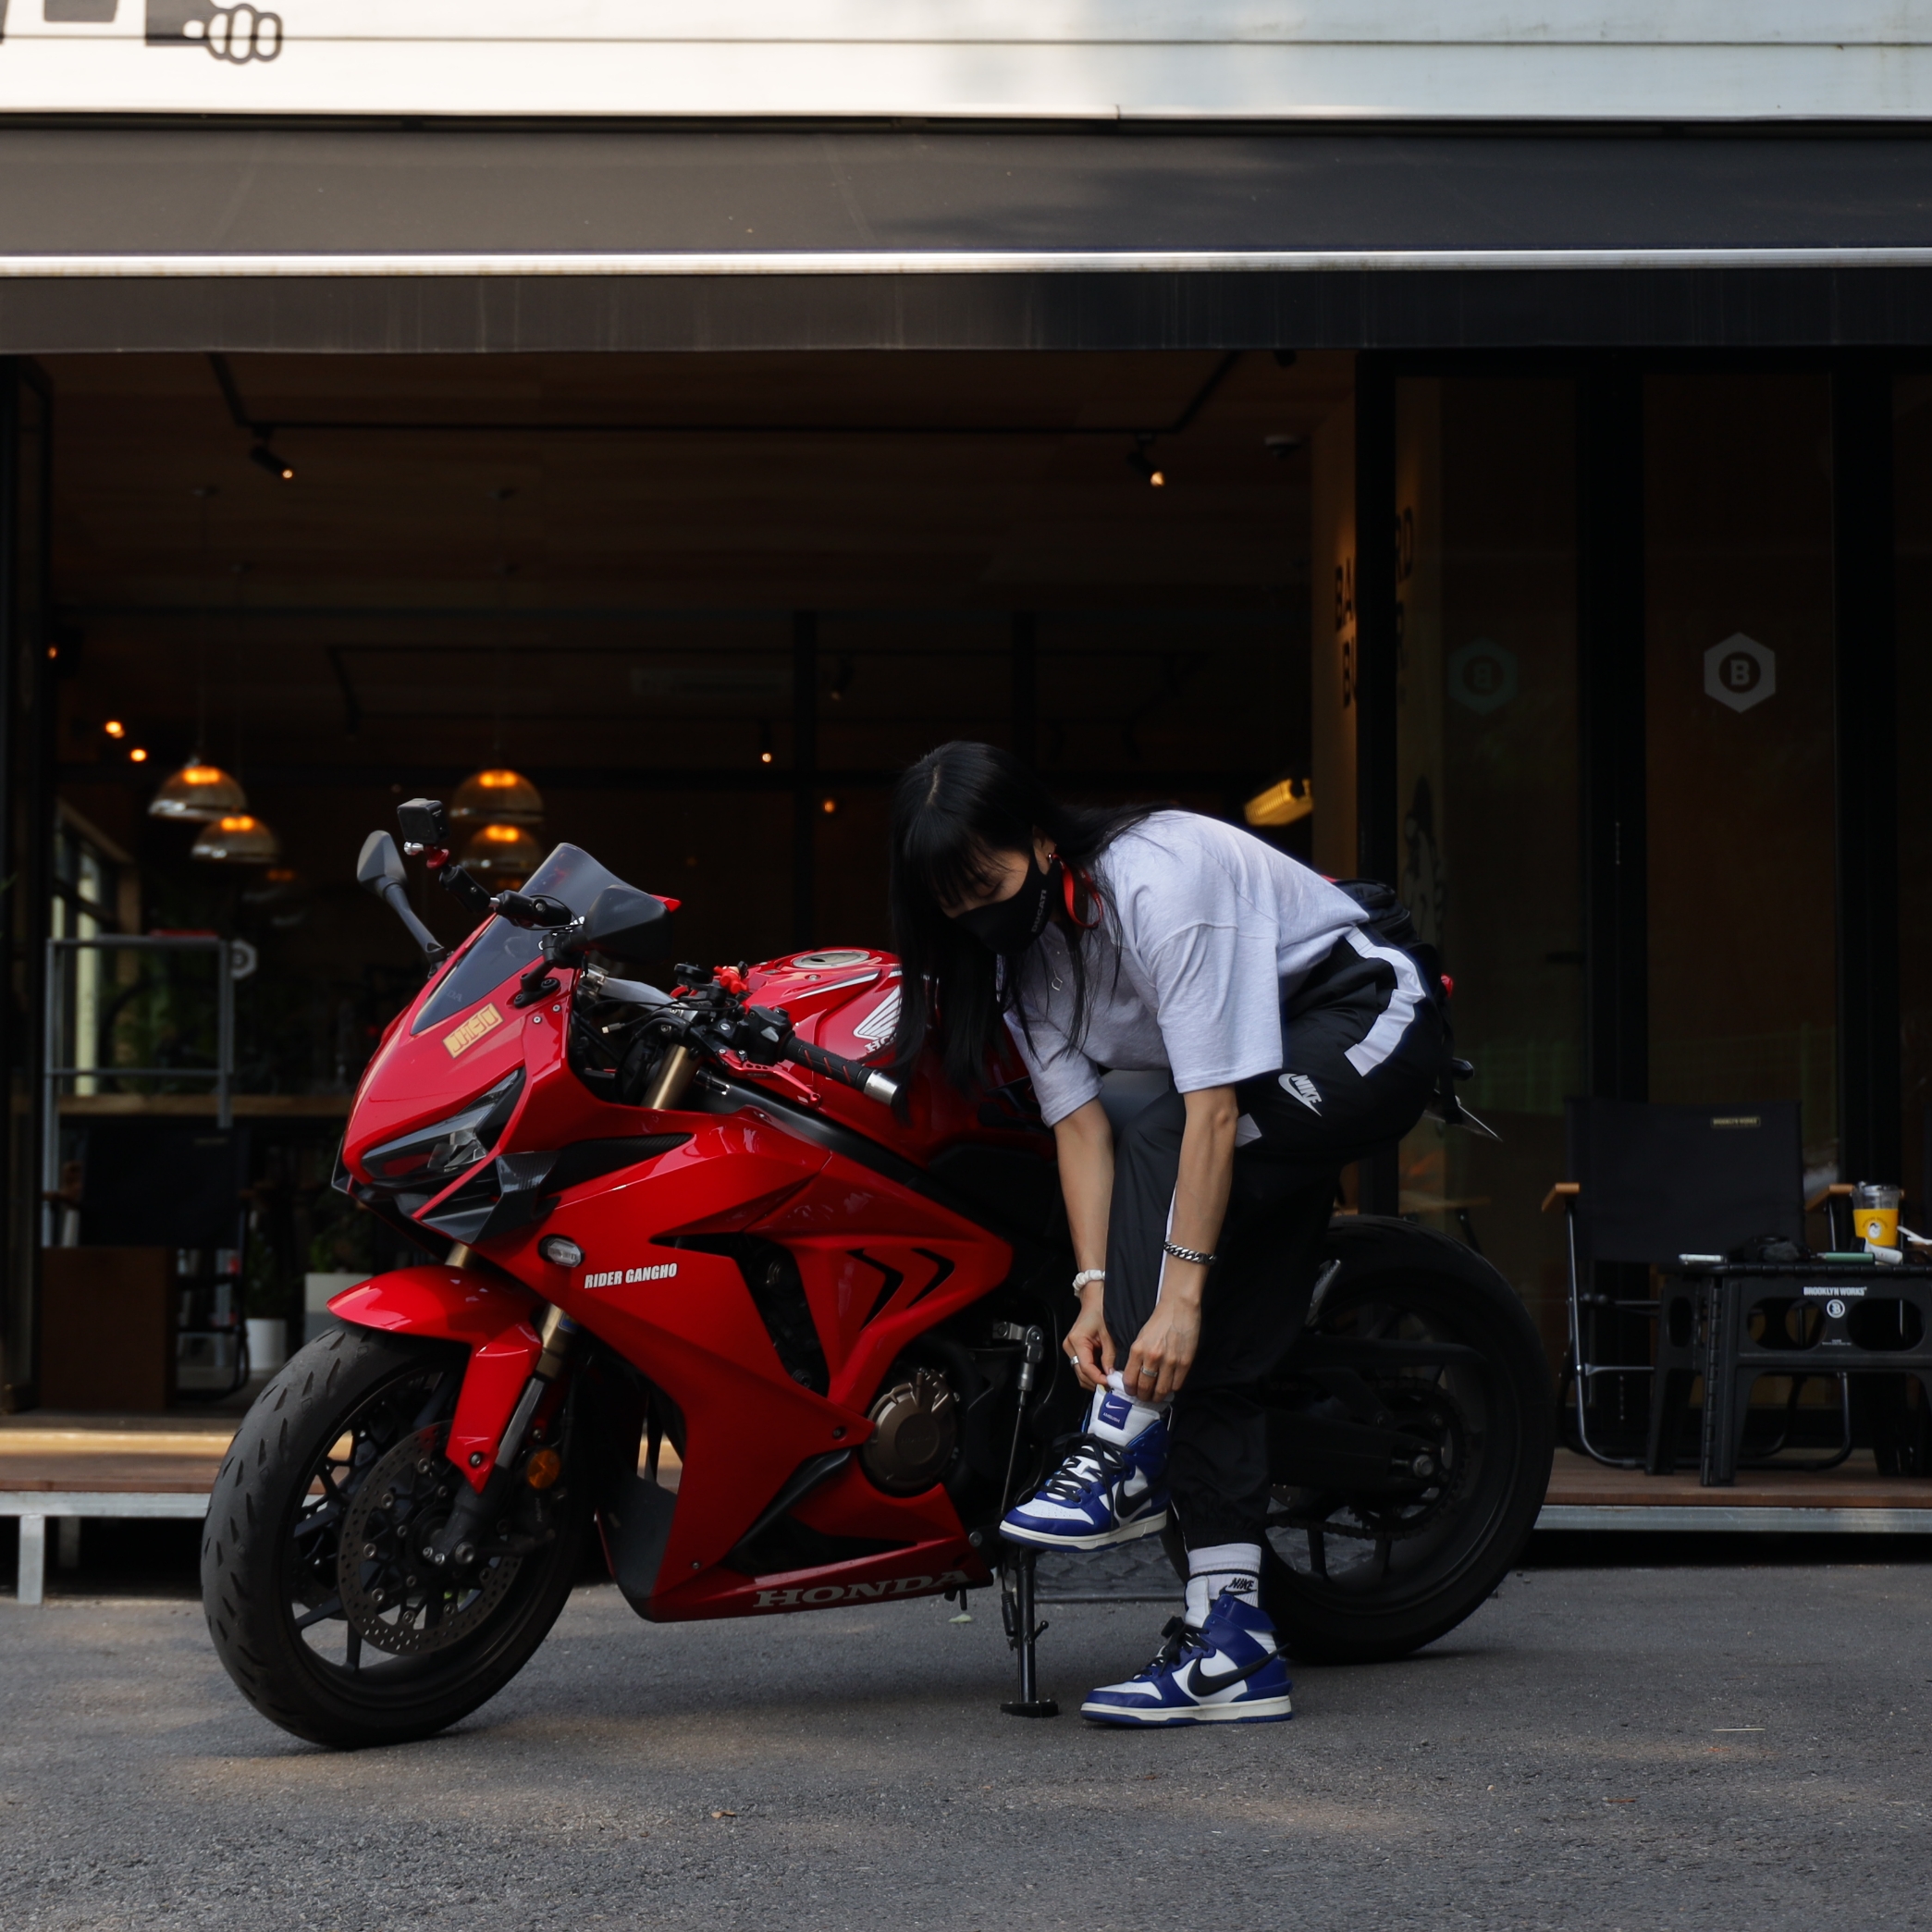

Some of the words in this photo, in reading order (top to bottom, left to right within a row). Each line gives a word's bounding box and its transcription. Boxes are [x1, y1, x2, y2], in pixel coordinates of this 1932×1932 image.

[1730, 659, 1751, 686] B
[1030, 889, 1047, 932] DUCATI
[1290, 1074, 1323, 1103] NIKE
[584, 1270, 623, 1289] RIDER
[624, 1262, 678, 1284] GANGHO
[1803, 1286, 1839, 1297] BROOKLYN
[752, 1569, 974, 1607] HONDA
[1228, 1577, 1255, 1590] NIKE
